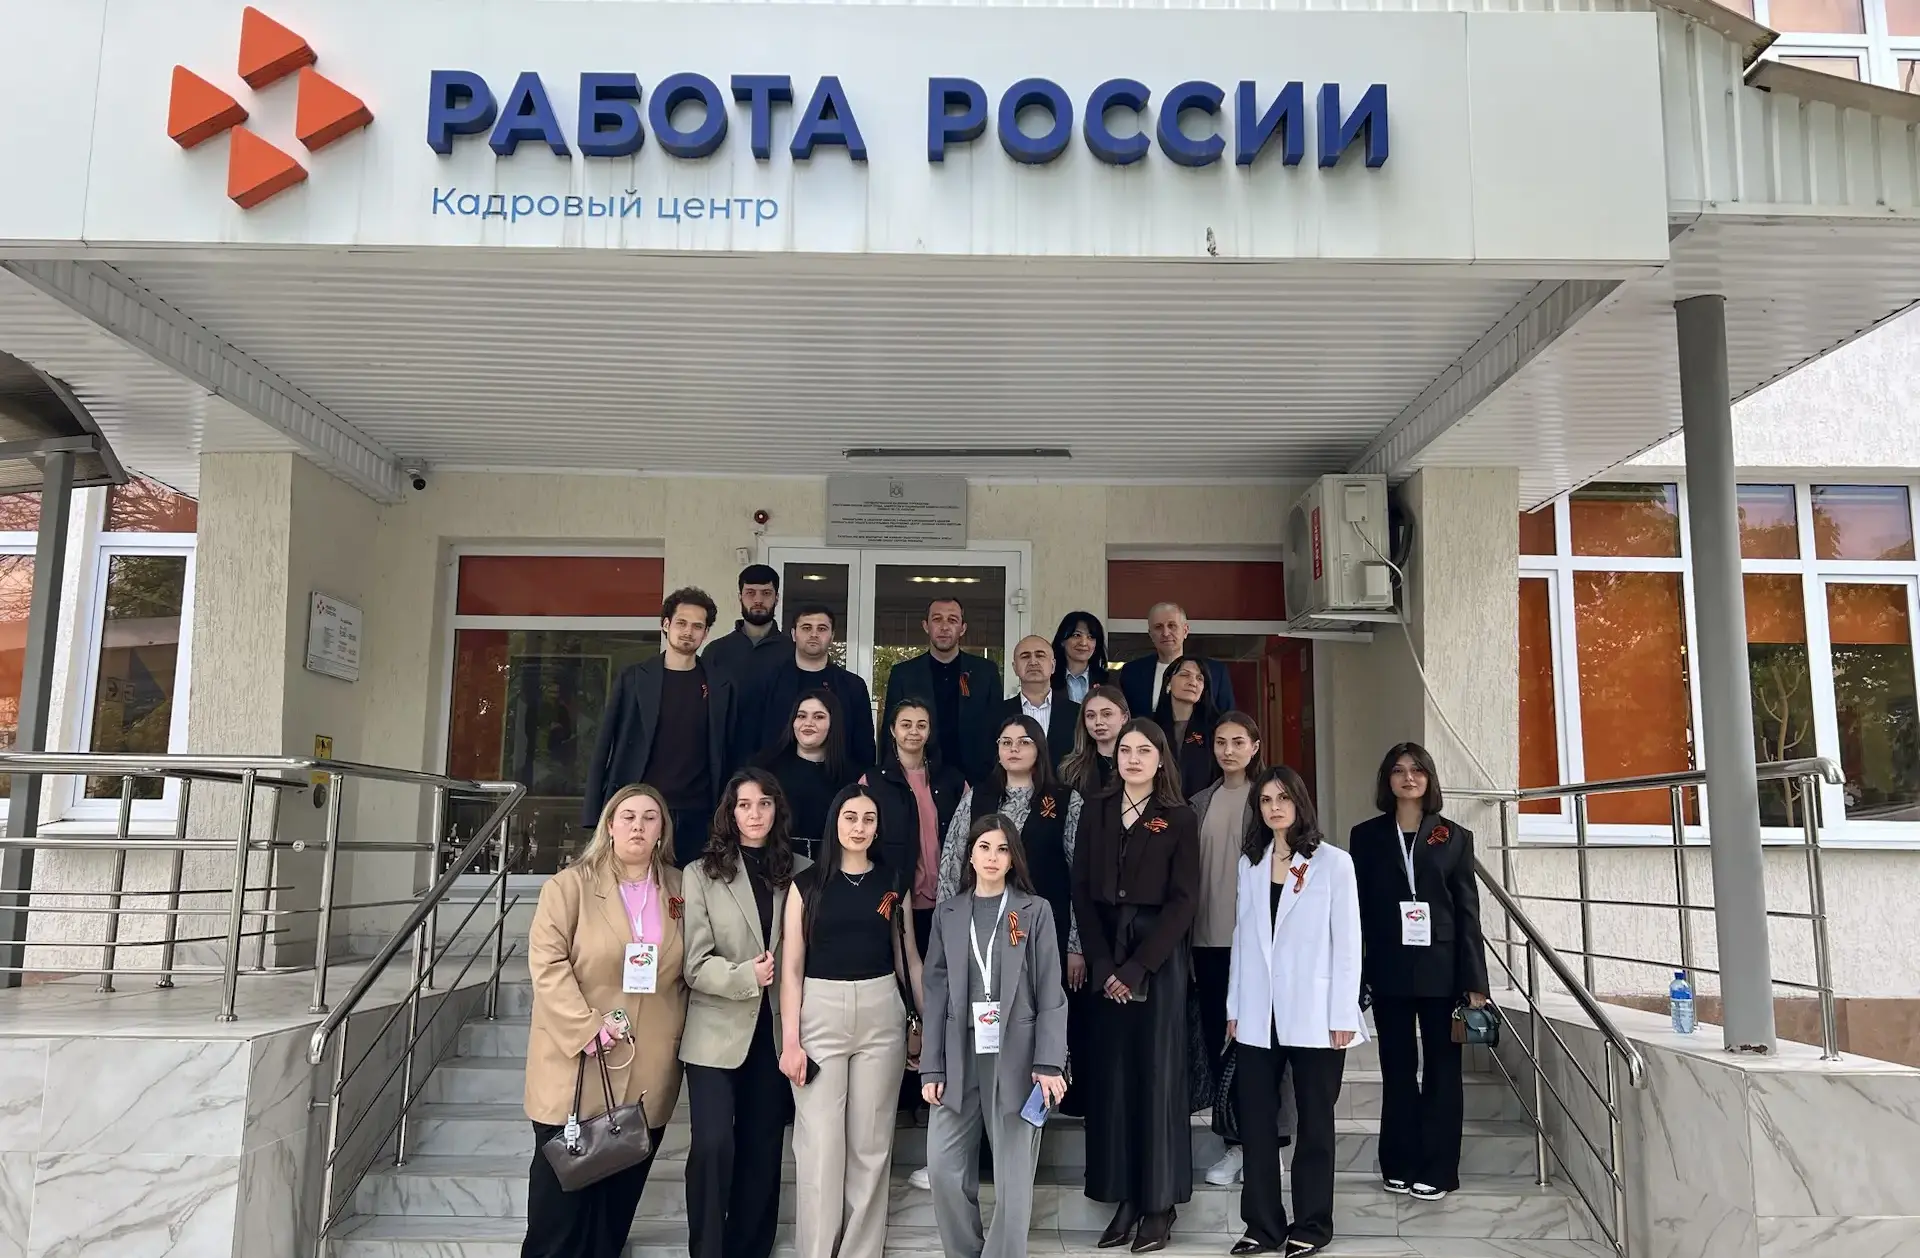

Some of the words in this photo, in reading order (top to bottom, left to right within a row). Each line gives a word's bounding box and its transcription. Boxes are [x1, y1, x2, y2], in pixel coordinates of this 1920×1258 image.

[427, 69, 868, 162] РАБОТА
[928, 77, 1388, 169] РОССИИ
[432, 187, 642, 223] Кадровый
[658, 197, 778, 227] центр
